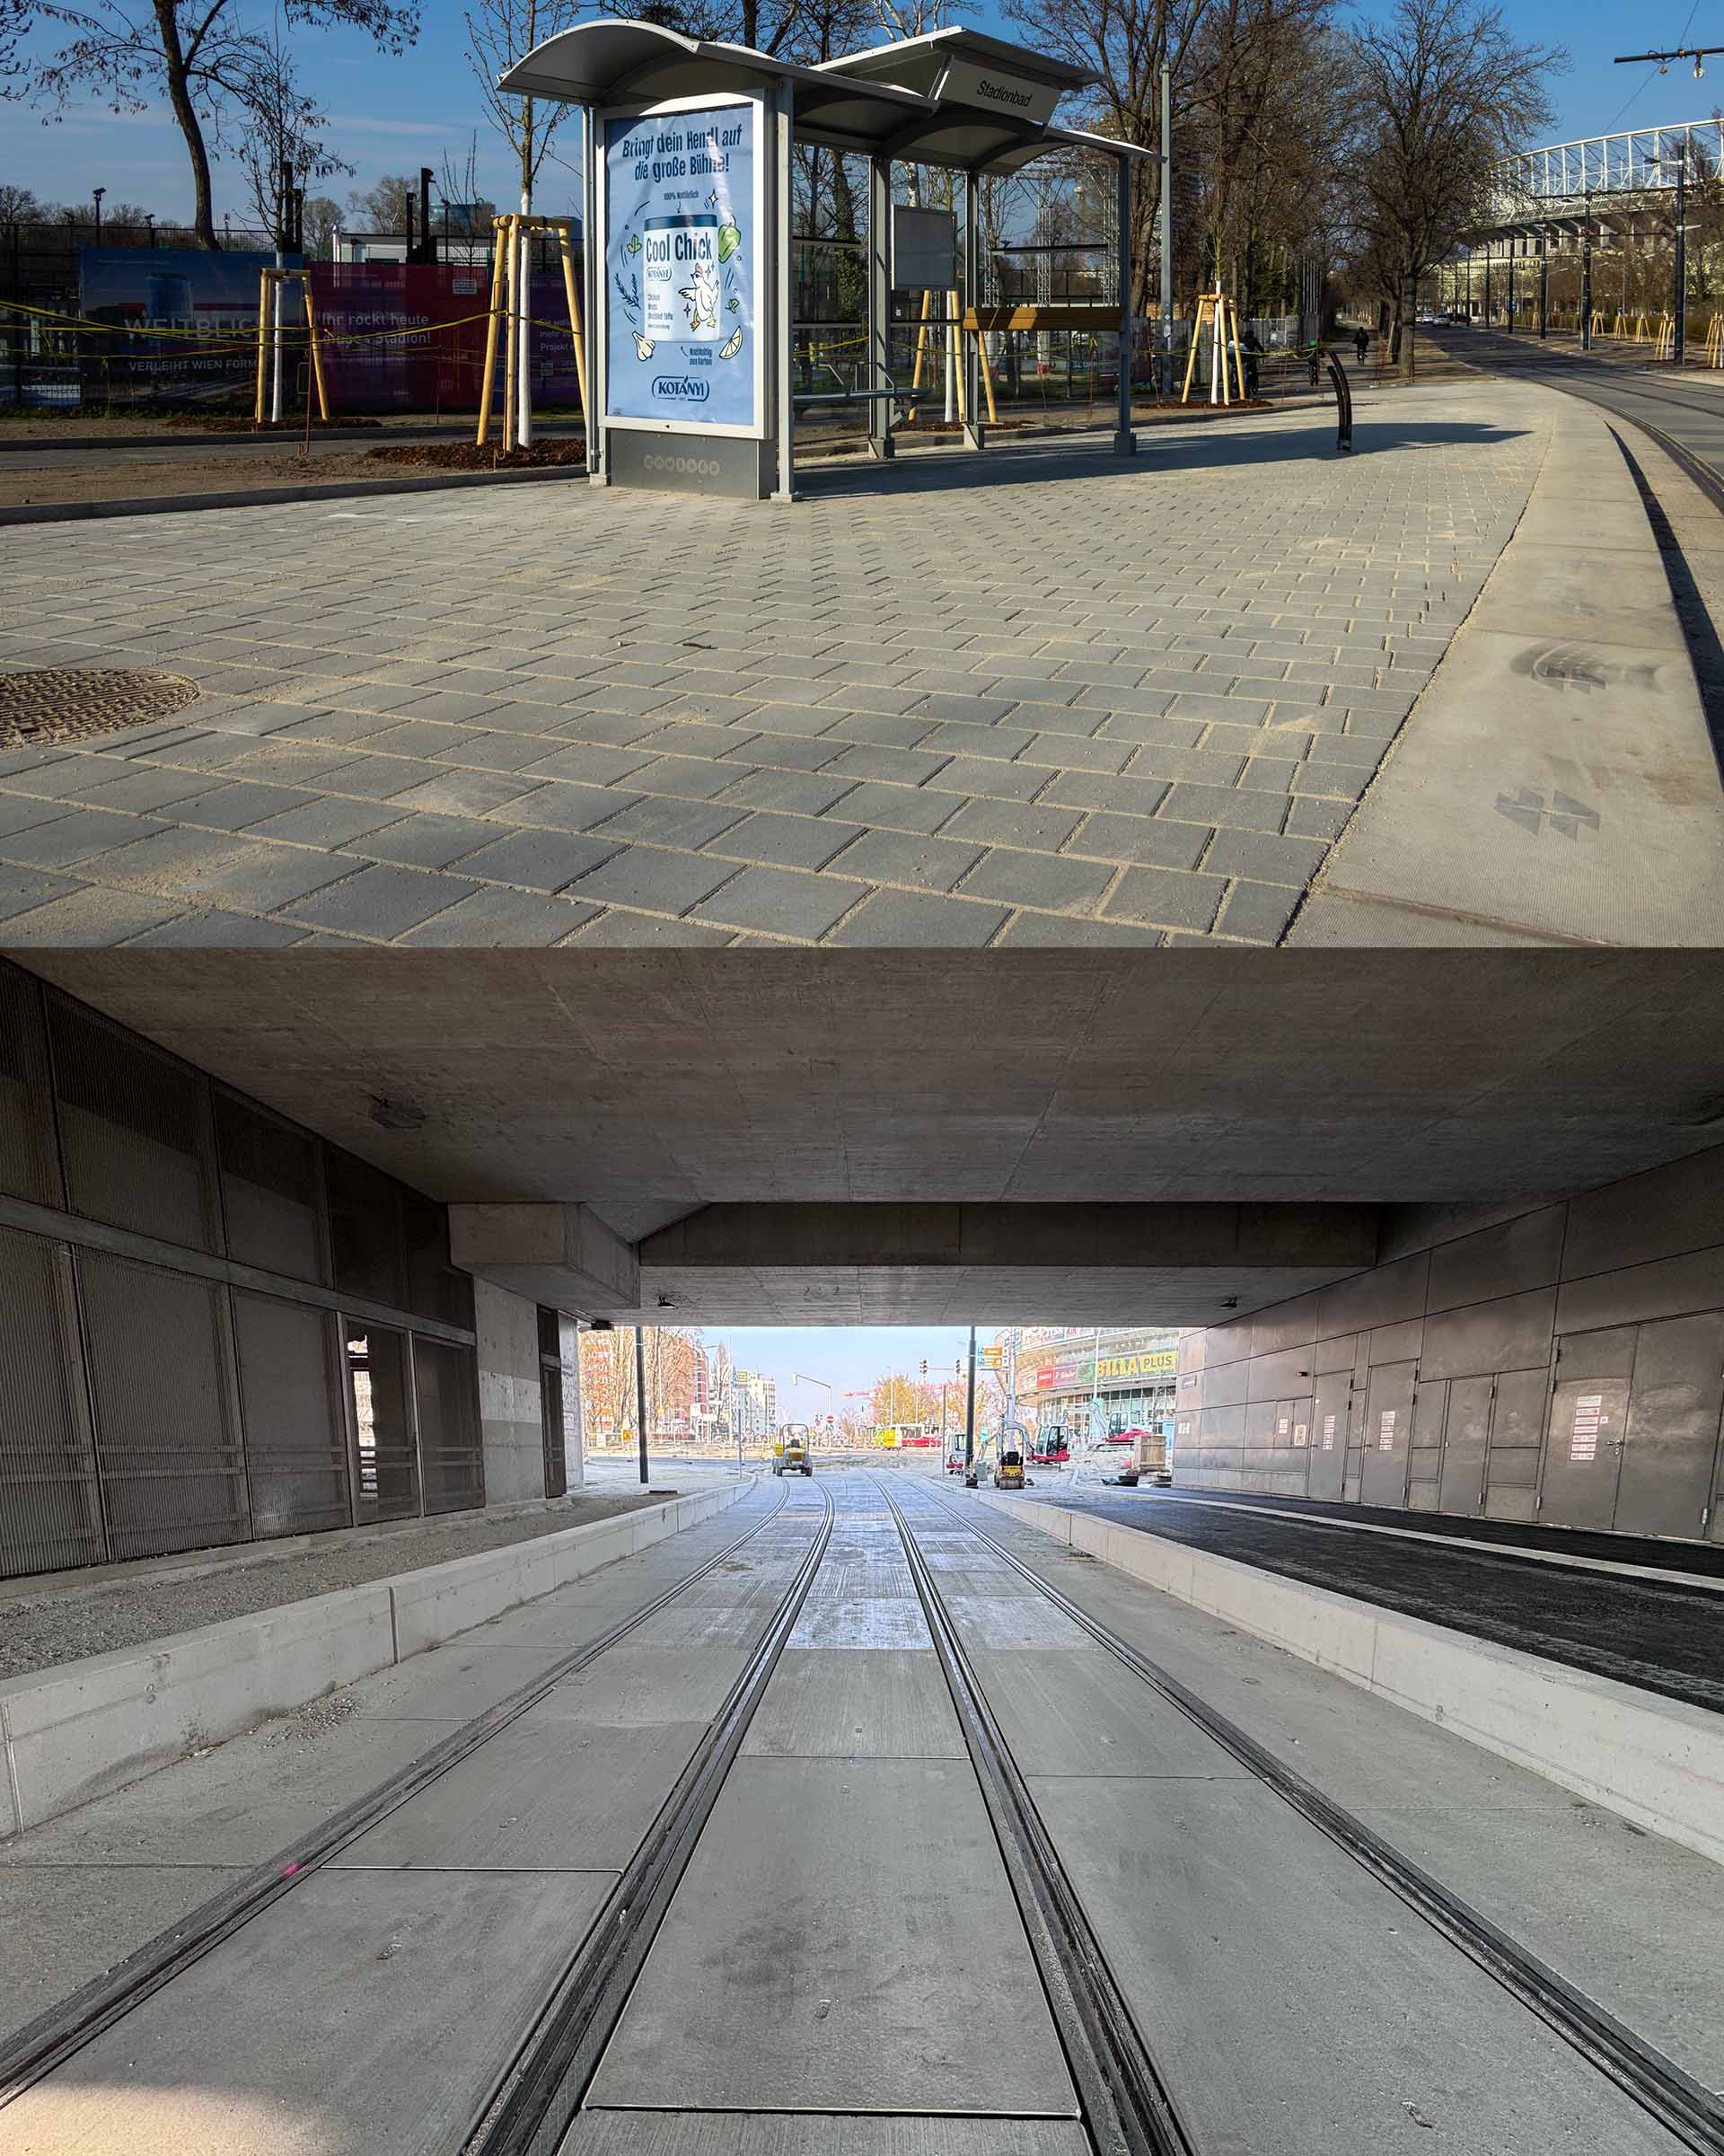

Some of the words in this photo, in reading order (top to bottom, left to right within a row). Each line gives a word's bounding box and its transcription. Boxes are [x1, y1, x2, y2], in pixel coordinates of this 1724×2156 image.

[977, 80, 1033, 107] Stadionbad
[622, 136, 654, 160] Bringt
[656, 132, 682, 154] dein
[687, 127, 718, 149] Hendl
[722, 124, 743, 147] auf
[635, 160, 648, 180] die
[653, 155, 686, 183] große
[690, 153, 729, 176] Bühne!
[646, 233, 669, 263] Cool
[674, 232, 713, 261] Chick
[124, 318, 252, 339] WEITBLIC
[322, 312, 343, 325] Ihr
[348, 312, 386, 325] rockt
[391, 312, 429, 325] heute
[375, 331, 431, 345] Stadion!
[129, 360, 189, 372] VERLEIHT
[191, 360, 224, 370] WIEN
[226, 359, 258, 370] FORM
[658, 375, 704, 396] KOTÁNYI
[1098, 1357, 1136, 1377] BILLA
[1143, 1355, 1172, 1369] PLUS
